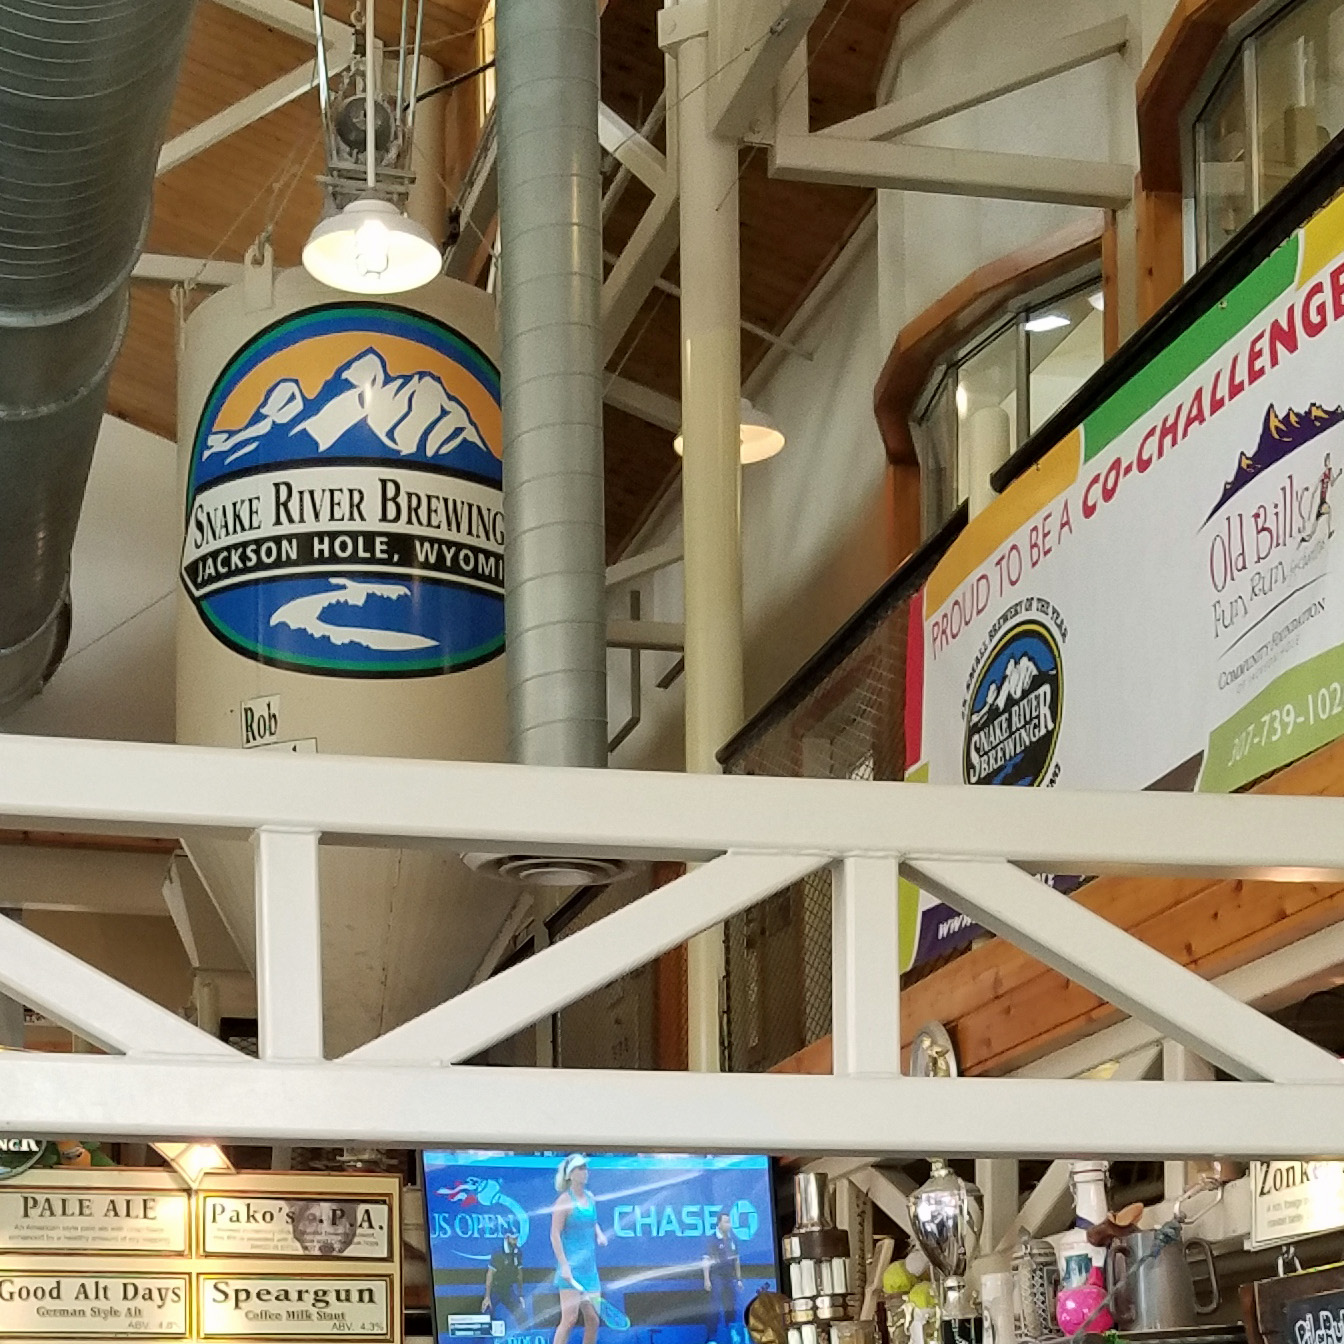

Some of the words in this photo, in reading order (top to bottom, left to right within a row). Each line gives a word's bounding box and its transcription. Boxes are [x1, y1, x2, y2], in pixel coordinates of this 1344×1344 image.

[194, 494, 262, 551] SNAKE
[272, 481, 368, 528] RIVER
[378, 477, 505, 548] BREWING
[196, 537, 299, 585] JACKSON
[313, 534, 400, 563] HOLE,
[1209, 512, 1248, 593] Old
[931, 573, 992, 660] PROUD
[994, 545, 1023, 592] TO
[1029, 528, 1052, 576] BE
[1056, 500, 1073, 551] A
[1211, 595, 1249, 640] Fun
[1249, 560, 1288, 602] Run
[243, 701, 279, 745] Rob
[1011, 683, 1055, 736] RIVER
[979, 717, 1040, 780] BREWING
[21, 1195, 94, 1219] PALE
[104, 1198, 158, 1221] ALE
[211, 1202, 297, 1226] Pako's
[454, 1213, 516, 1239] OPEN
[613, 1204, 722, 1238] CHASE
[74, 1280, 111, 1301] Alt
[121, 1282, 182, 1310] Days
[212, 1280, 379, 1311] Speargun
[244, 1309, 284, 1322] Coffee
[285, 1310, 315, 1322] Milk
[316, 1310, 347, 1323] Stout
